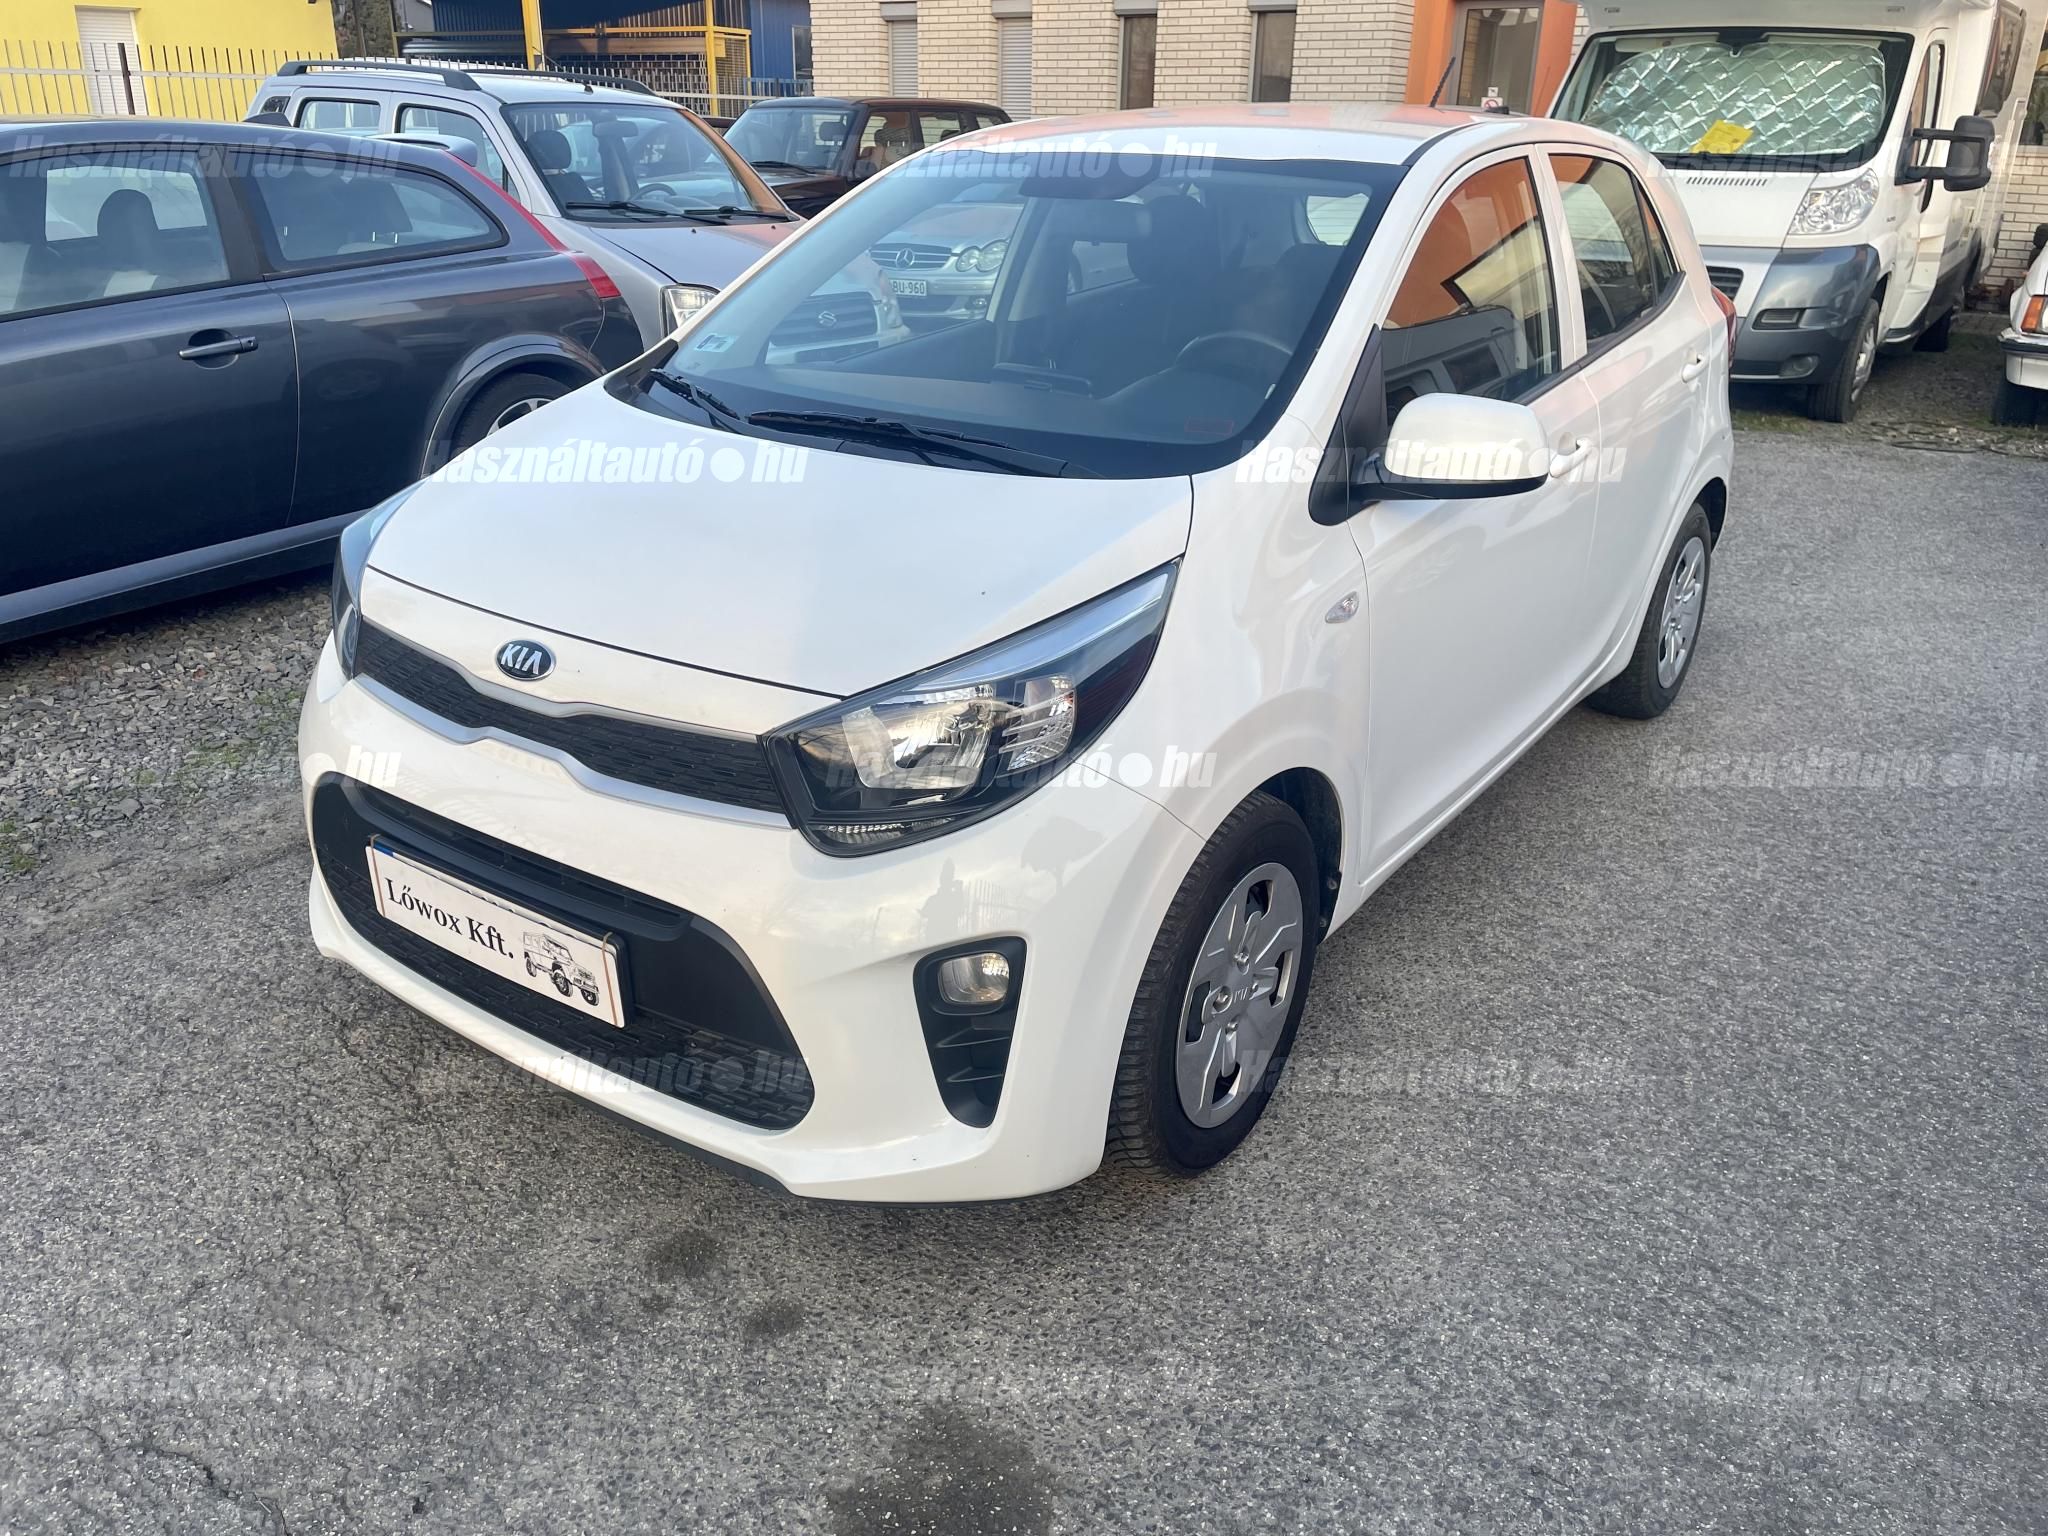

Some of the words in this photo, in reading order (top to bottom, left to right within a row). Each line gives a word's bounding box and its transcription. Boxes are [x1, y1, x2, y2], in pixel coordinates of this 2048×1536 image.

[891, 280, 925, 295] BU-960
[500, 643, 543, 675] KIA
[384, 877, 463, 936] Lőwox
[465, 915, 515, 960] Kft.
